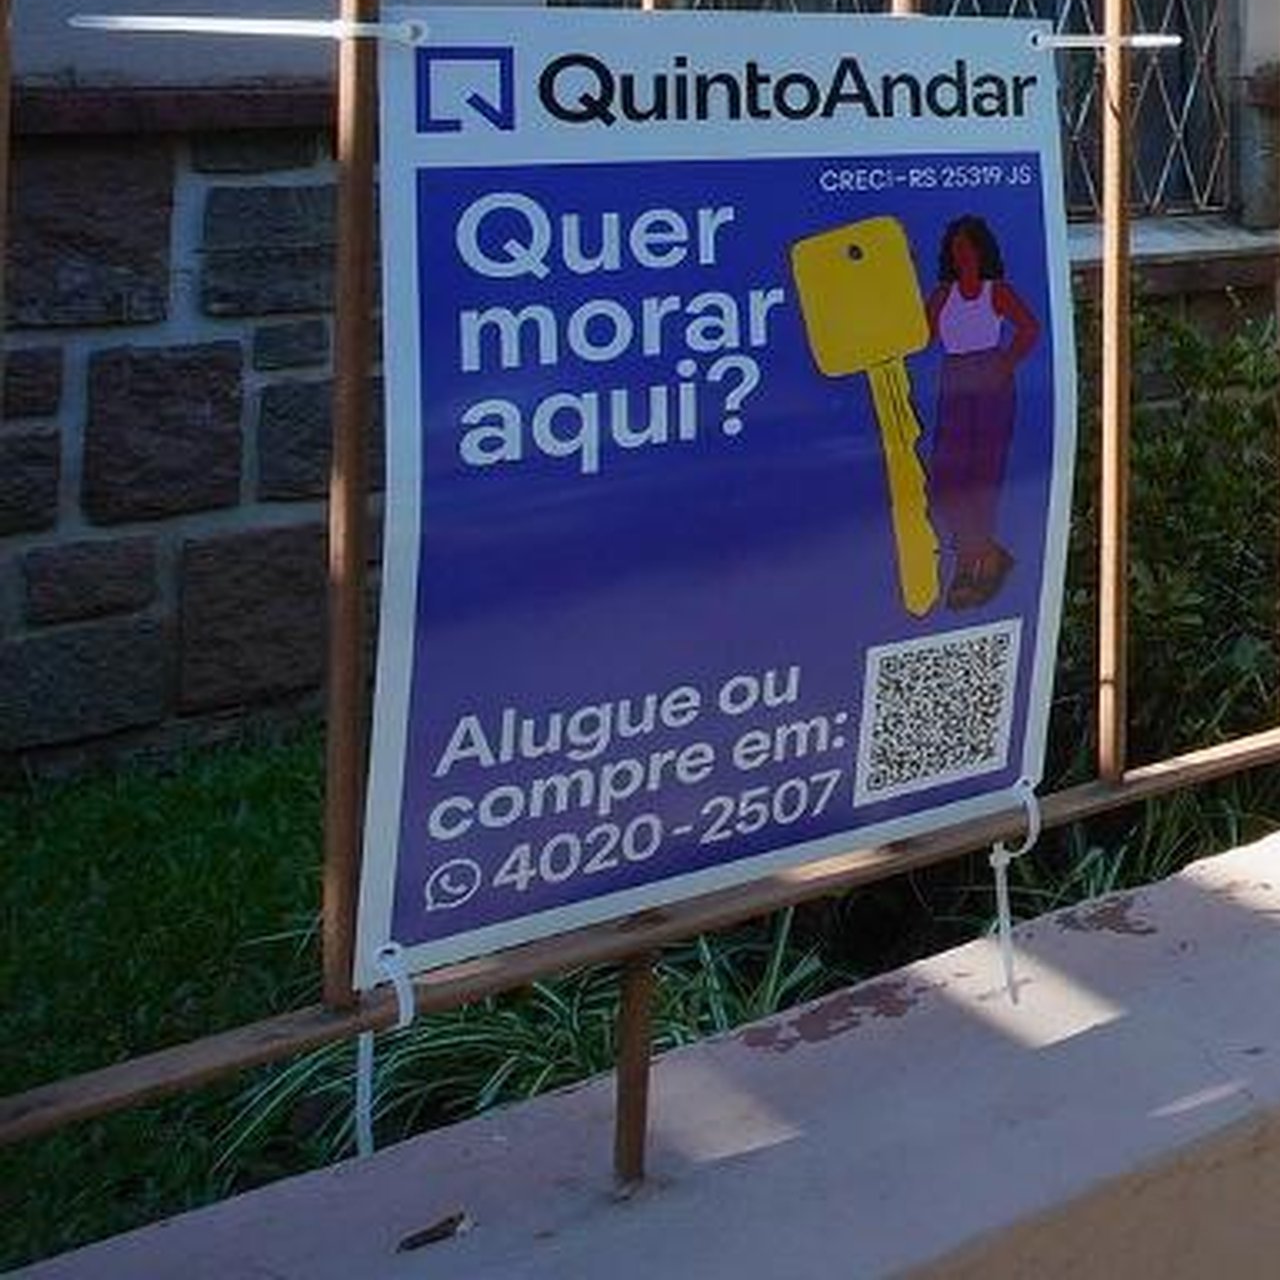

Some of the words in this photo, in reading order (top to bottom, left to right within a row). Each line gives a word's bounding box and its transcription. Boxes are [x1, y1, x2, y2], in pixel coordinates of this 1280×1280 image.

[538, 52, 1037, 129] QuintoAndar
[455, 191, 736, 280] Quer
[460, 286, 785, 372] morar
[459, 354, 762, 474] aqui?
[427, 741, 715, 841] compre
[732, 710, 849, 770] em:
[433, 682, 702, 777] Alugue
[717, 665, 801, 715] ou
[491, 769, 843, 892] 4020-2507
